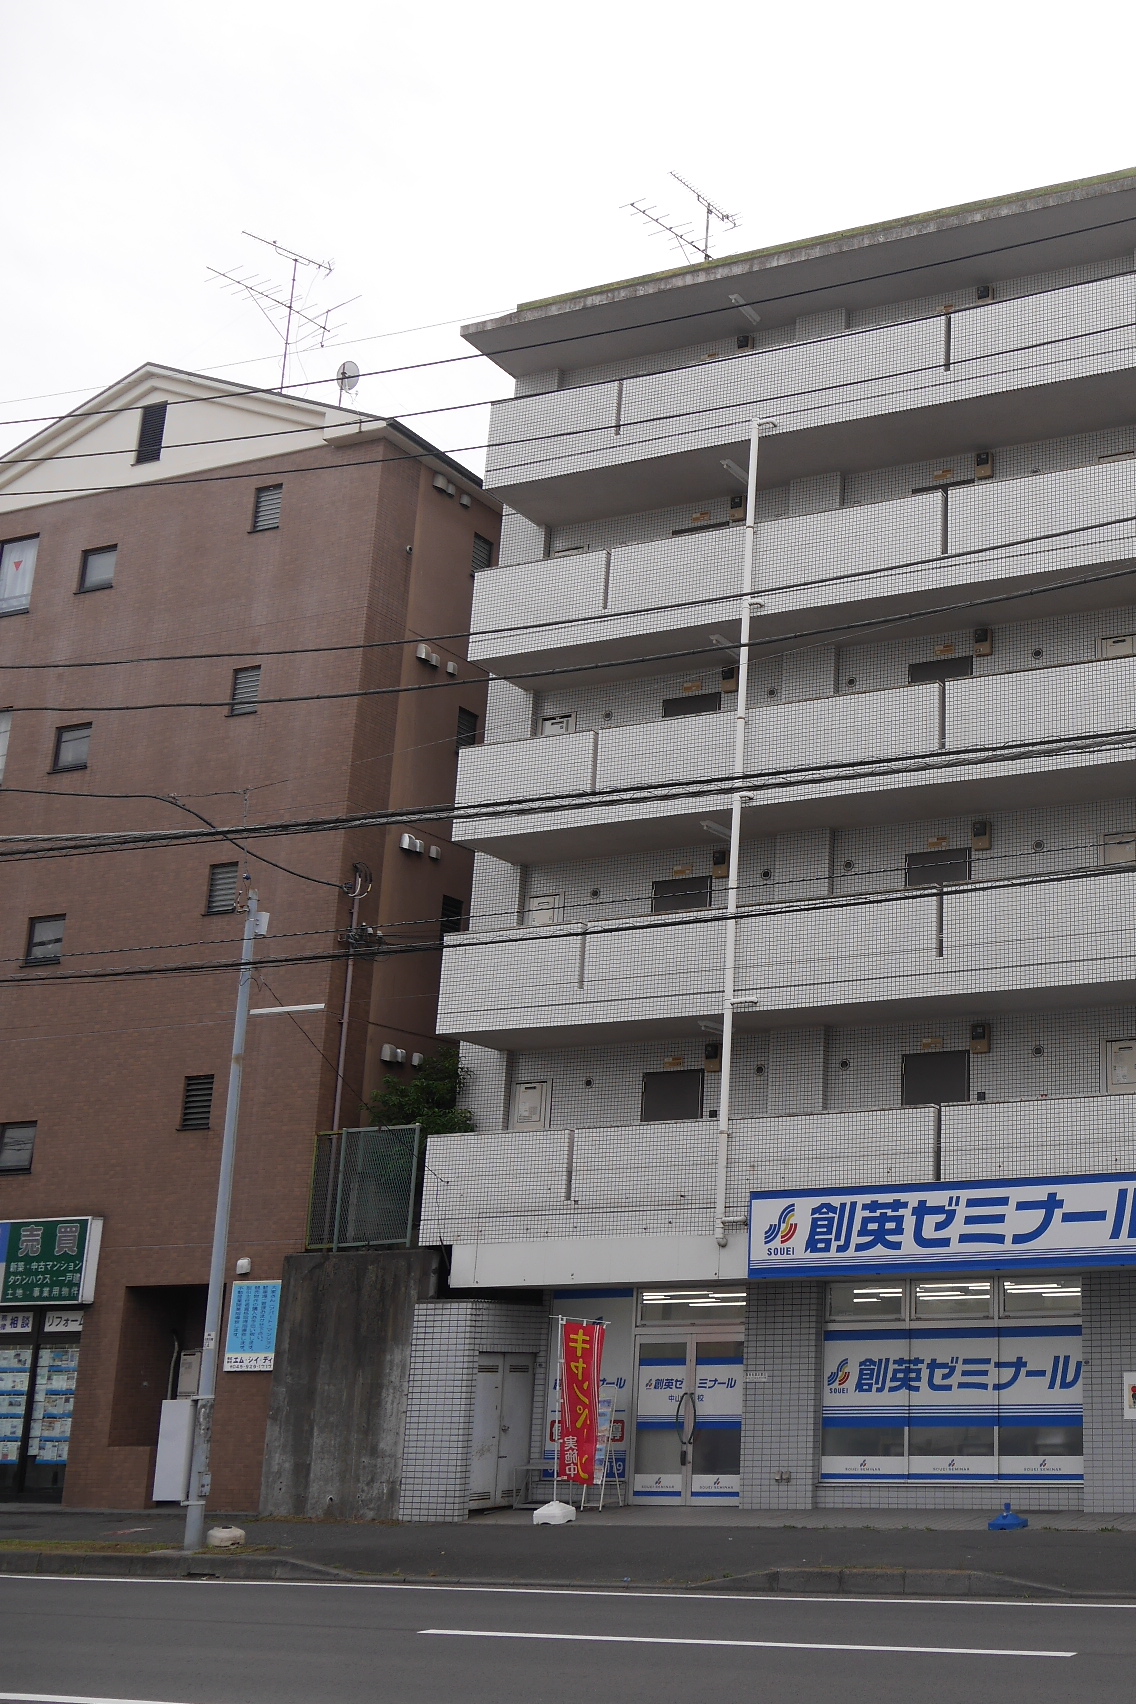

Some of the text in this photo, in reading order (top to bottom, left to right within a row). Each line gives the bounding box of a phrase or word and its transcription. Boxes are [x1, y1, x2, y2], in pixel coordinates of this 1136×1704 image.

[18, 1223, 80, 1257] 売買
[767, 1246, 795, 1256] SOUEI
[9, 1315, 31, 1329] 相談
[854, 1354, 1083, 1393] 創英ゼミナール
[653, 1377, 737, 1390] 創英ゼ ミナール
